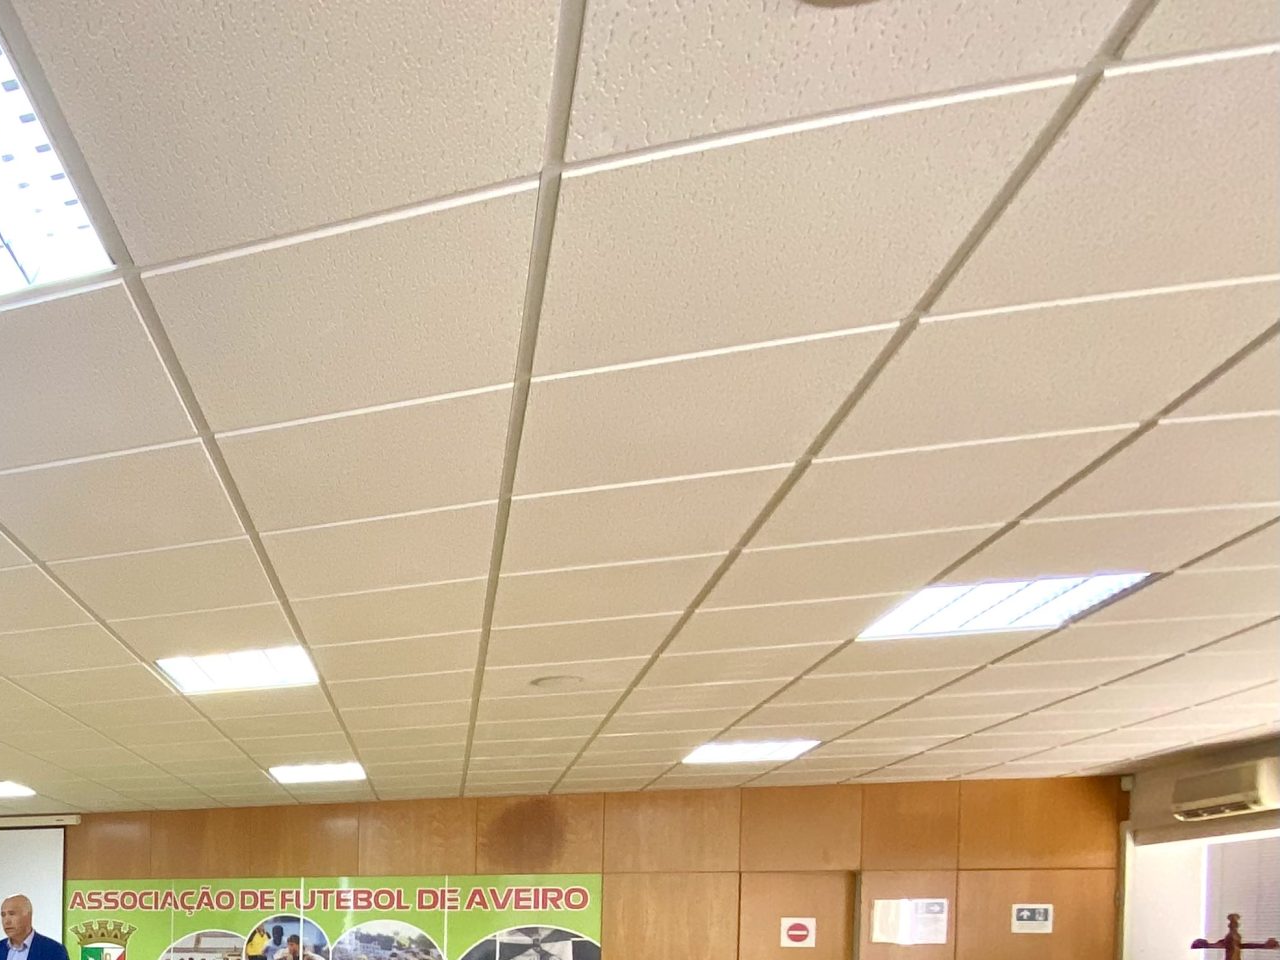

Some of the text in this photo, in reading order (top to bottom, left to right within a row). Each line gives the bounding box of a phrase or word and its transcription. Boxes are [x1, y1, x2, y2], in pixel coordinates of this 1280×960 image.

[69, 886, 590, 915] ASSOCIAÇÃO DE FUTEBOL DE AVEIRO
